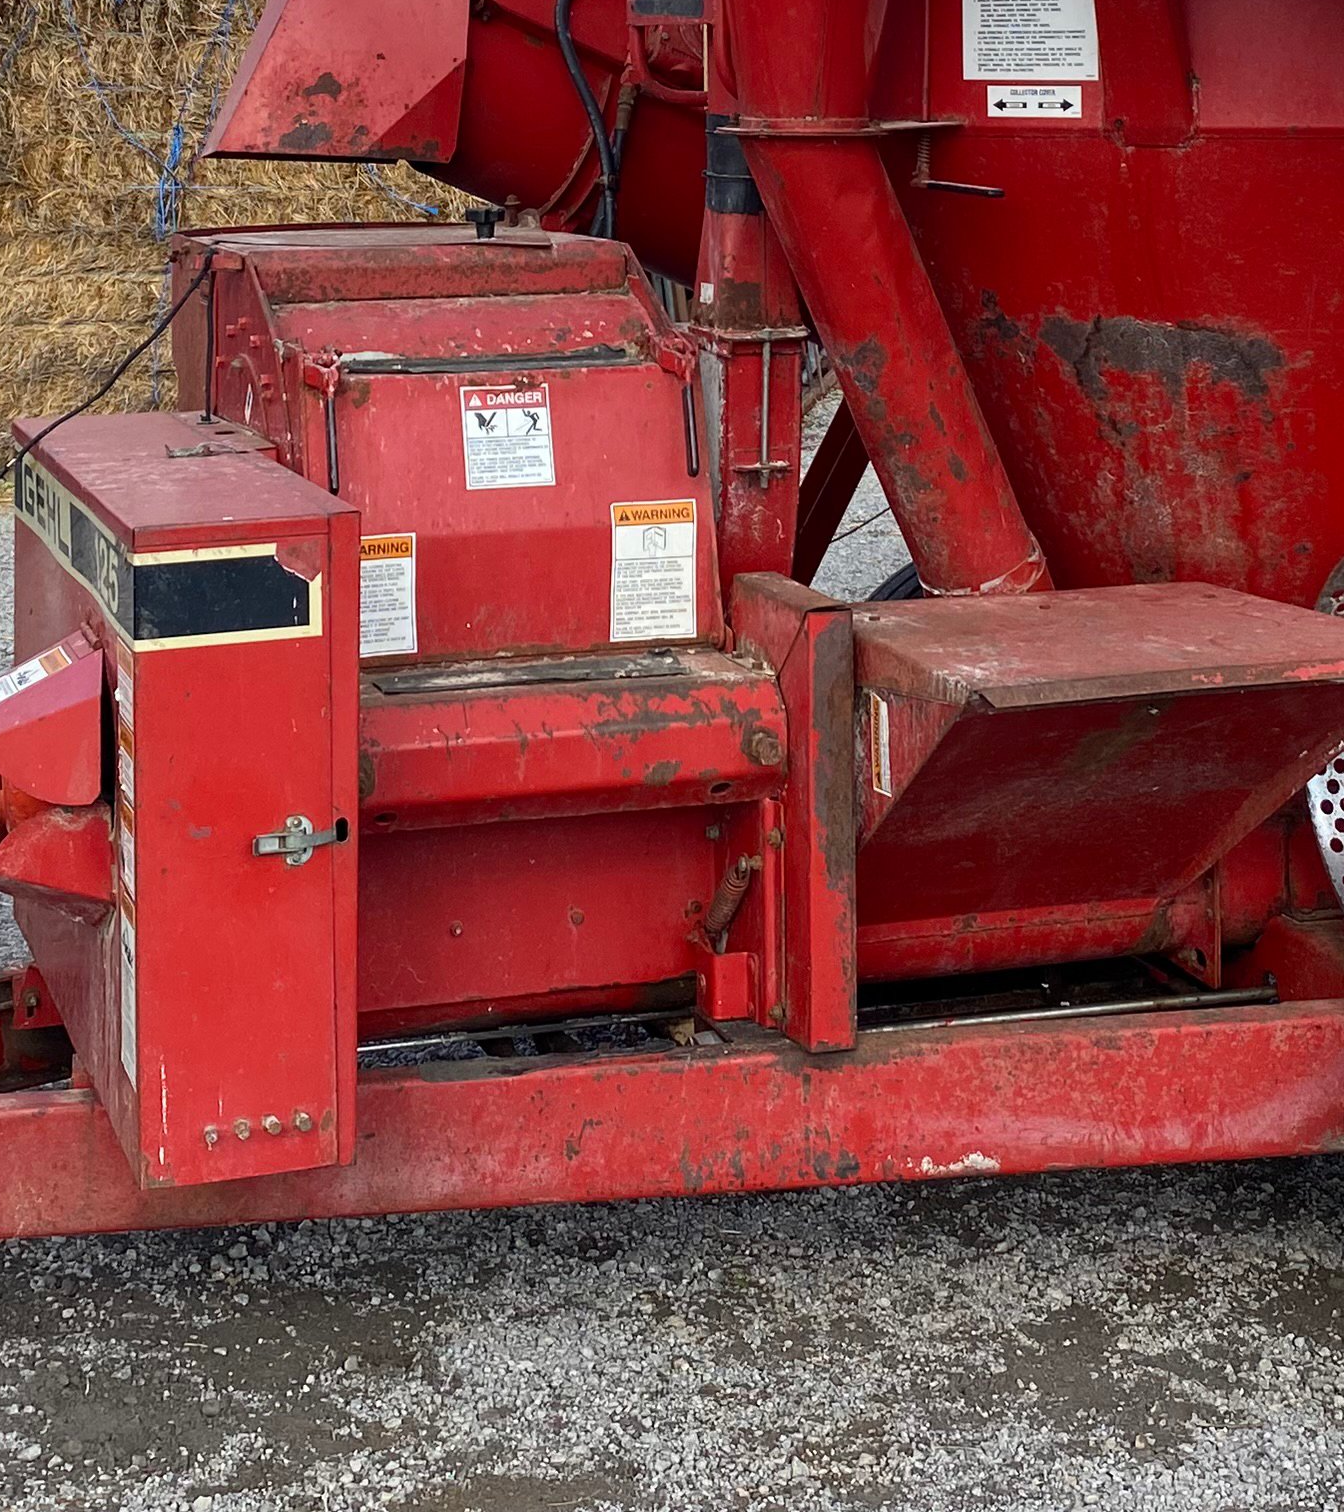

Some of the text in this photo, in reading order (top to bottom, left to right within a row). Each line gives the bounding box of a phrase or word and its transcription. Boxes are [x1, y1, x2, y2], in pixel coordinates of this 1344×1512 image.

[486, 392, 542, 405] DANGER
[23, 462, 71, 560] GEHL
[630, 507, 690, 521] WARNING
[359, 542, 409, 556] ARNING
[94, 529, 120, 614] 125
